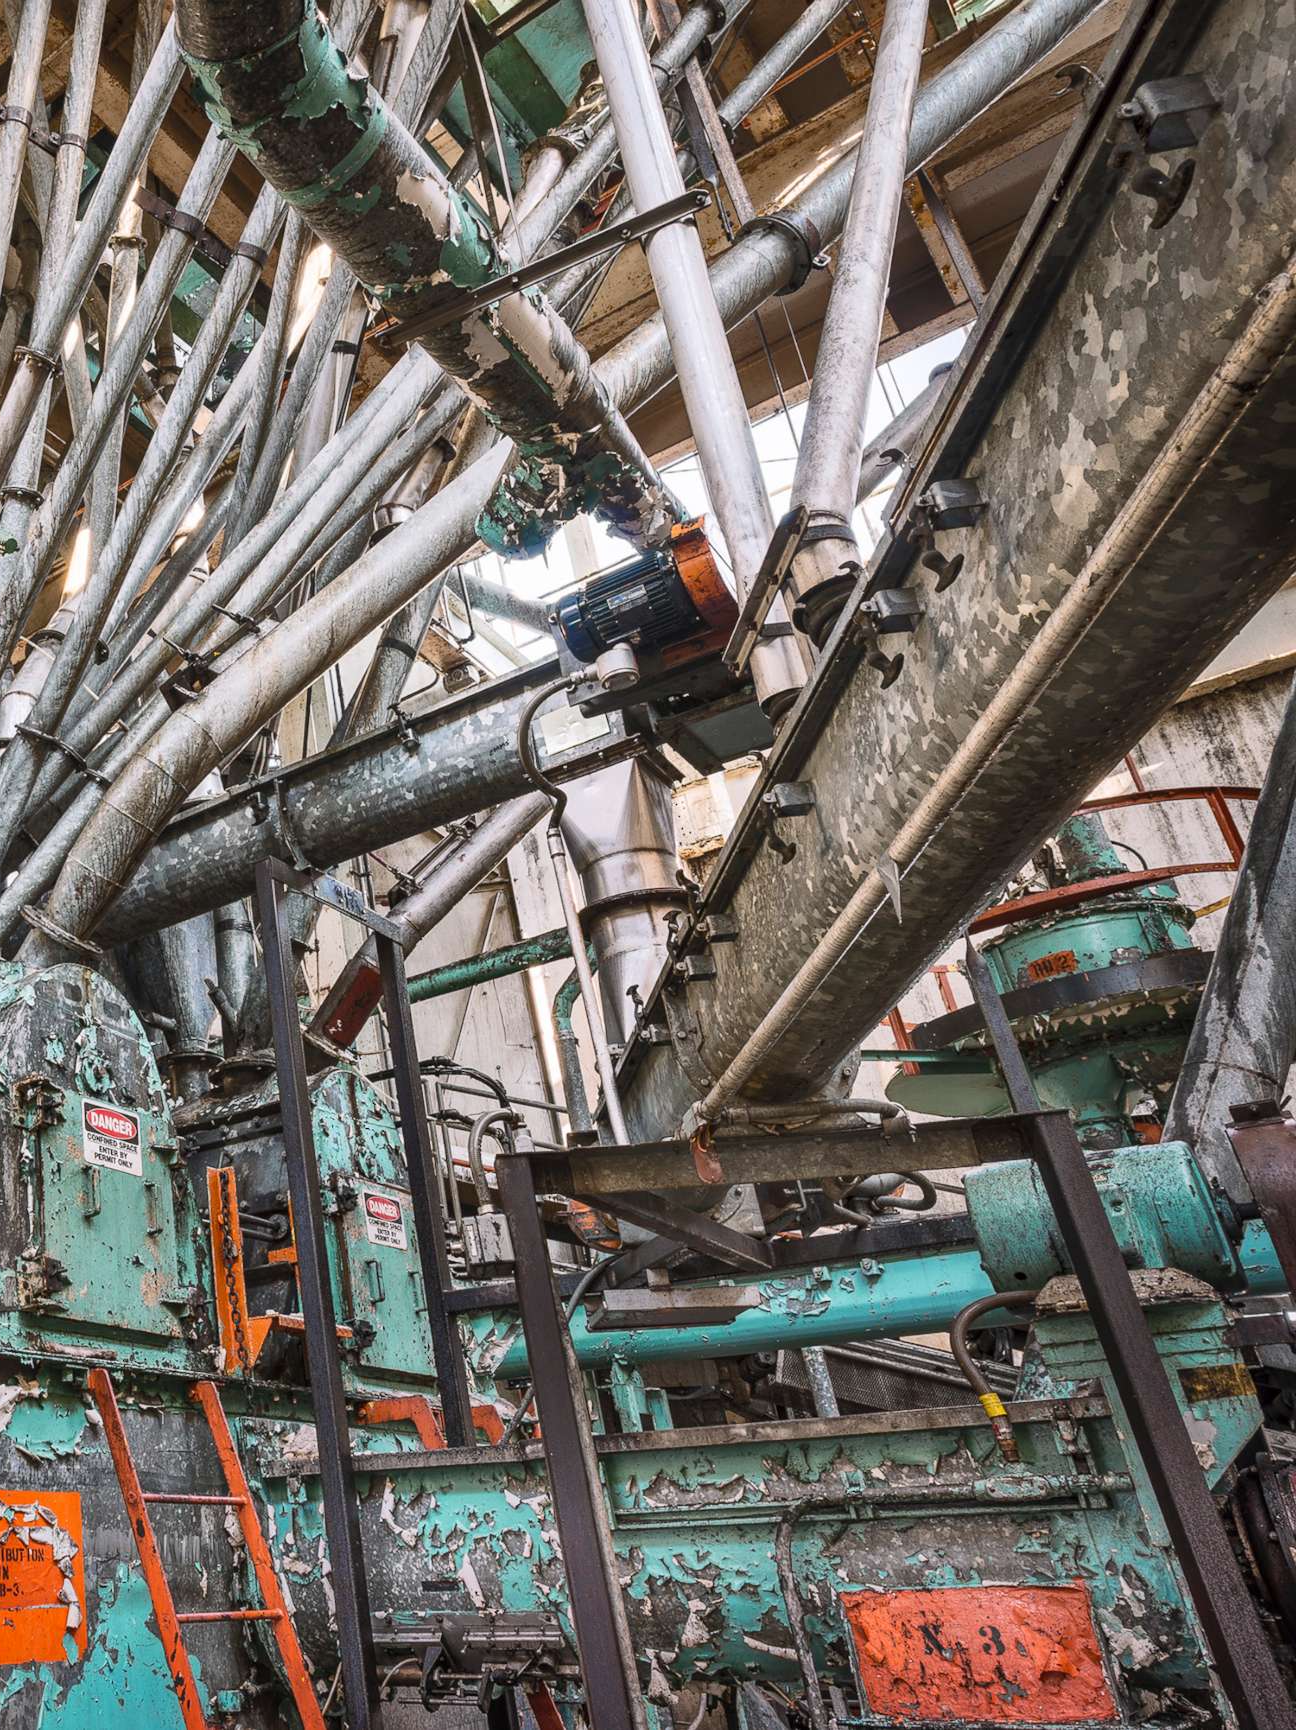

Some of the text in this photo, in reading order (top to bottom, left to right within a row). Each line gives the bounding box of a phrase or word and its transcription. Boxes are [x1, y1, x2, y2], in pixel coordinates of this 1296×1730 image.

[90, 1111, 132, 1136] DANGER
[87, 1133, 137, 1153] CONFINED SPACE
[99, 1146, 118, 1156] ENTER
[94, 1152, 132, 1168] PERMIT ONLY
[368, 1199, 399, 1217] DANGER
